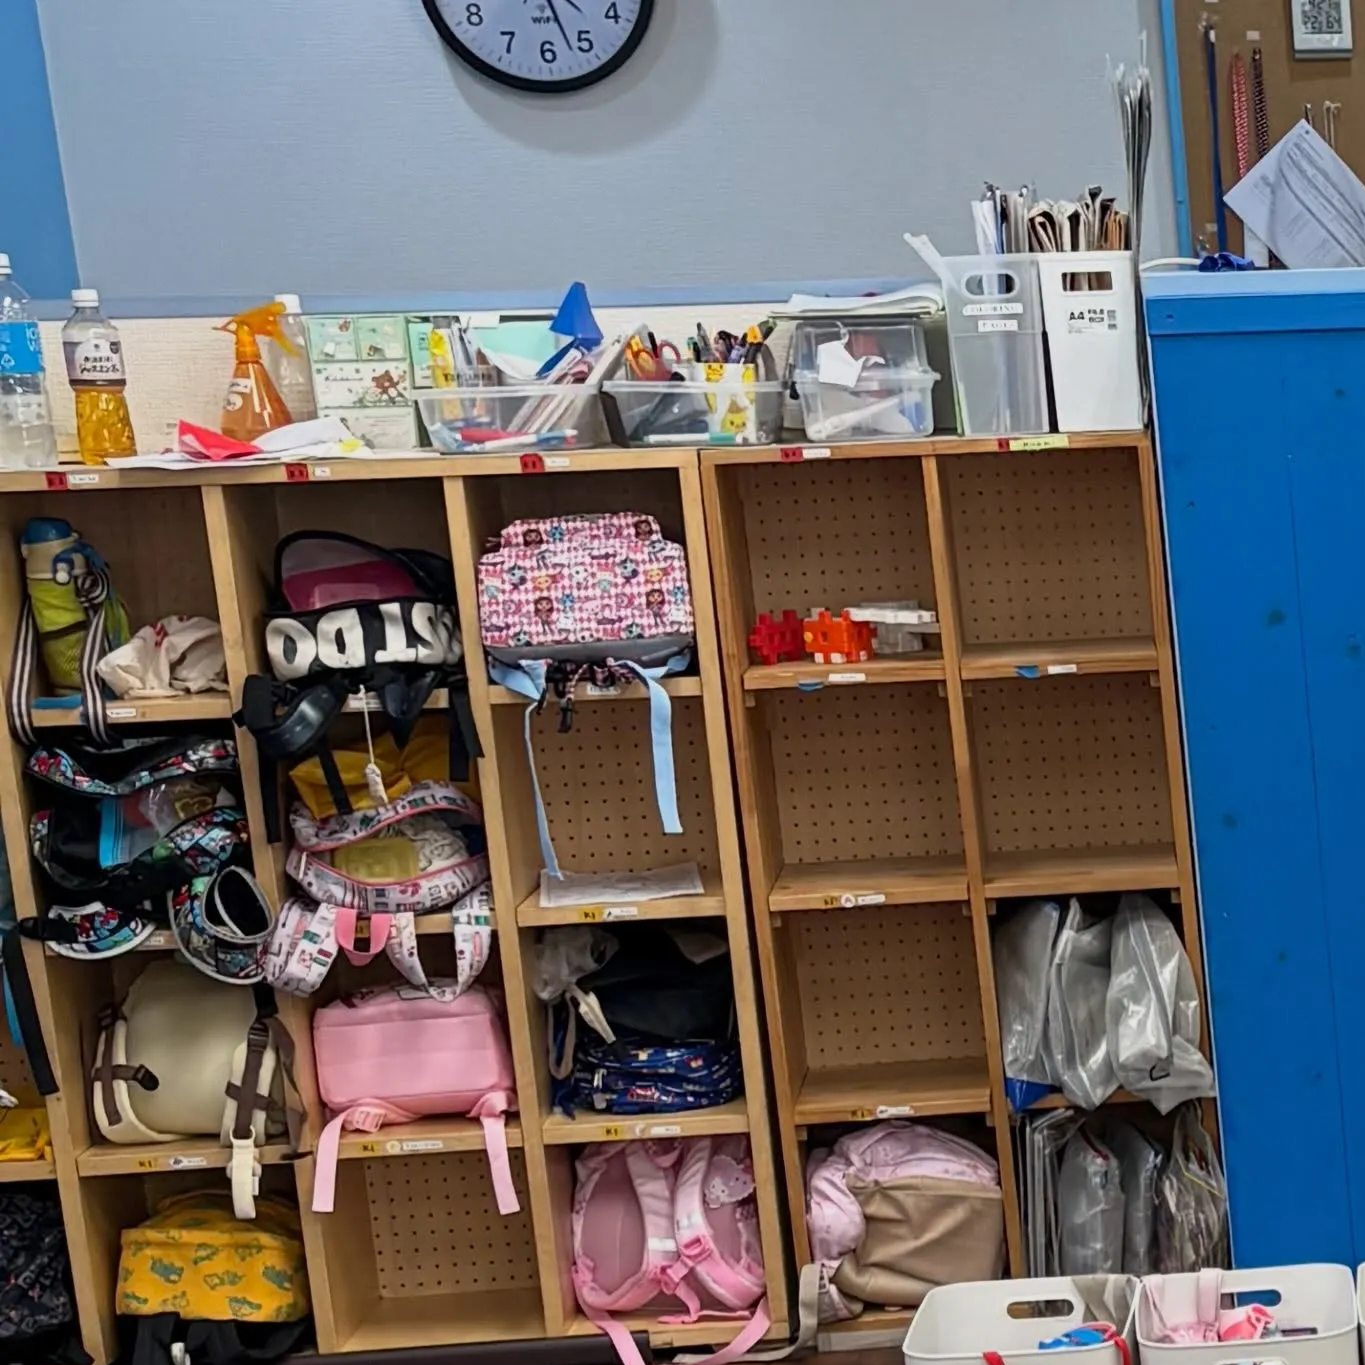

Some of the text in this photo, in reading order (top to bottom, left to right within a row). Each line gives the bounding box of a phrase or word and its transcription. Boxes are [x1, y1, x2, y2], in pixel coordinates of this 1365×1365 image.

[466, 3, 484, 26] 8
[604, 2, 621, 24] 4
[500, 31, 516, 54] 7
[539, 41, 557, 64] 6
[576, 30, 594, 53] 5
[1069, 311, 1085, 321] A4
